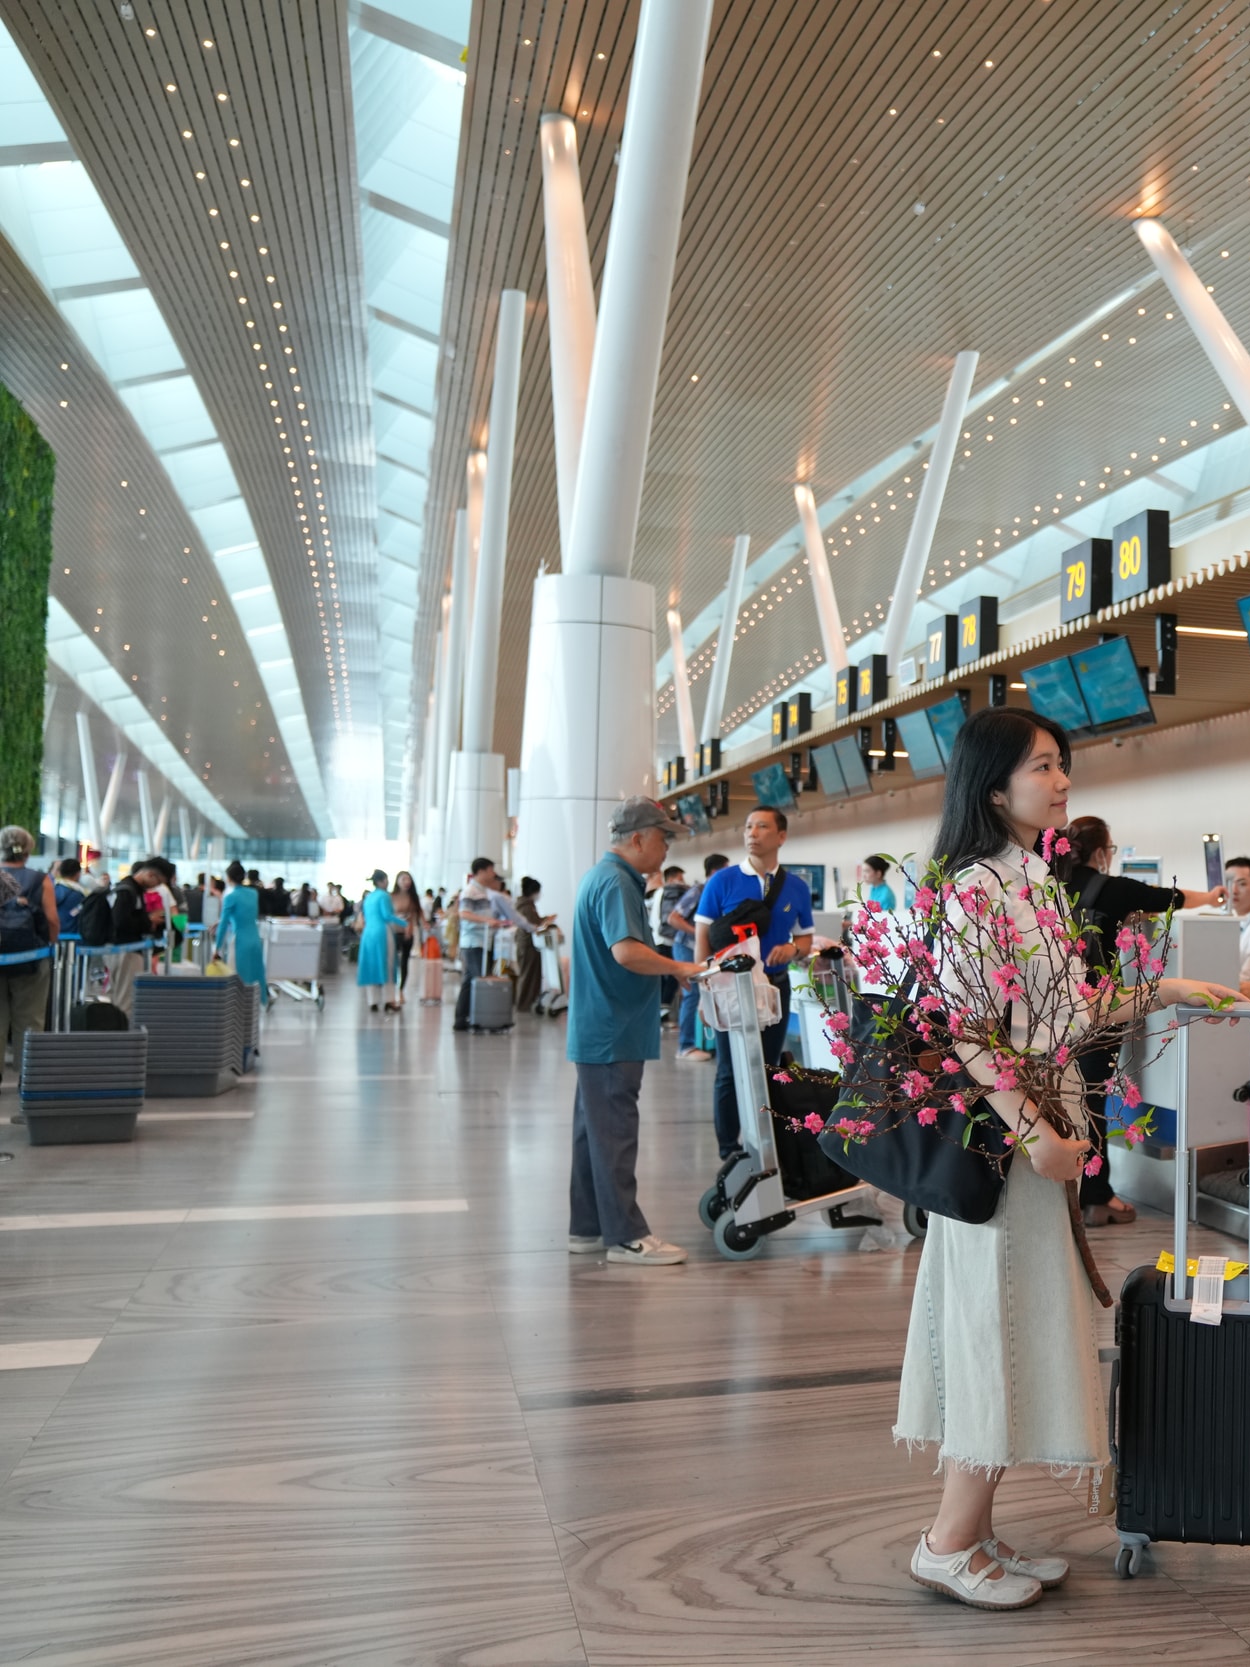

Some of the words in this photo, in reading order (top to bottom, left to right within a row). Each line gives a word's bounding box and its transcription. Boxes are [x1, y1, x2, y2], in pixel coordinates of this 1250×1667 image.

[1119, 535, 1141, 580] 80
[1066, 561, 1086, 601] 79
[929, 631, 943, 664] 77
[962, 612, 977, 648] 78
[1089, 1475, 1101, 1513] Busine
